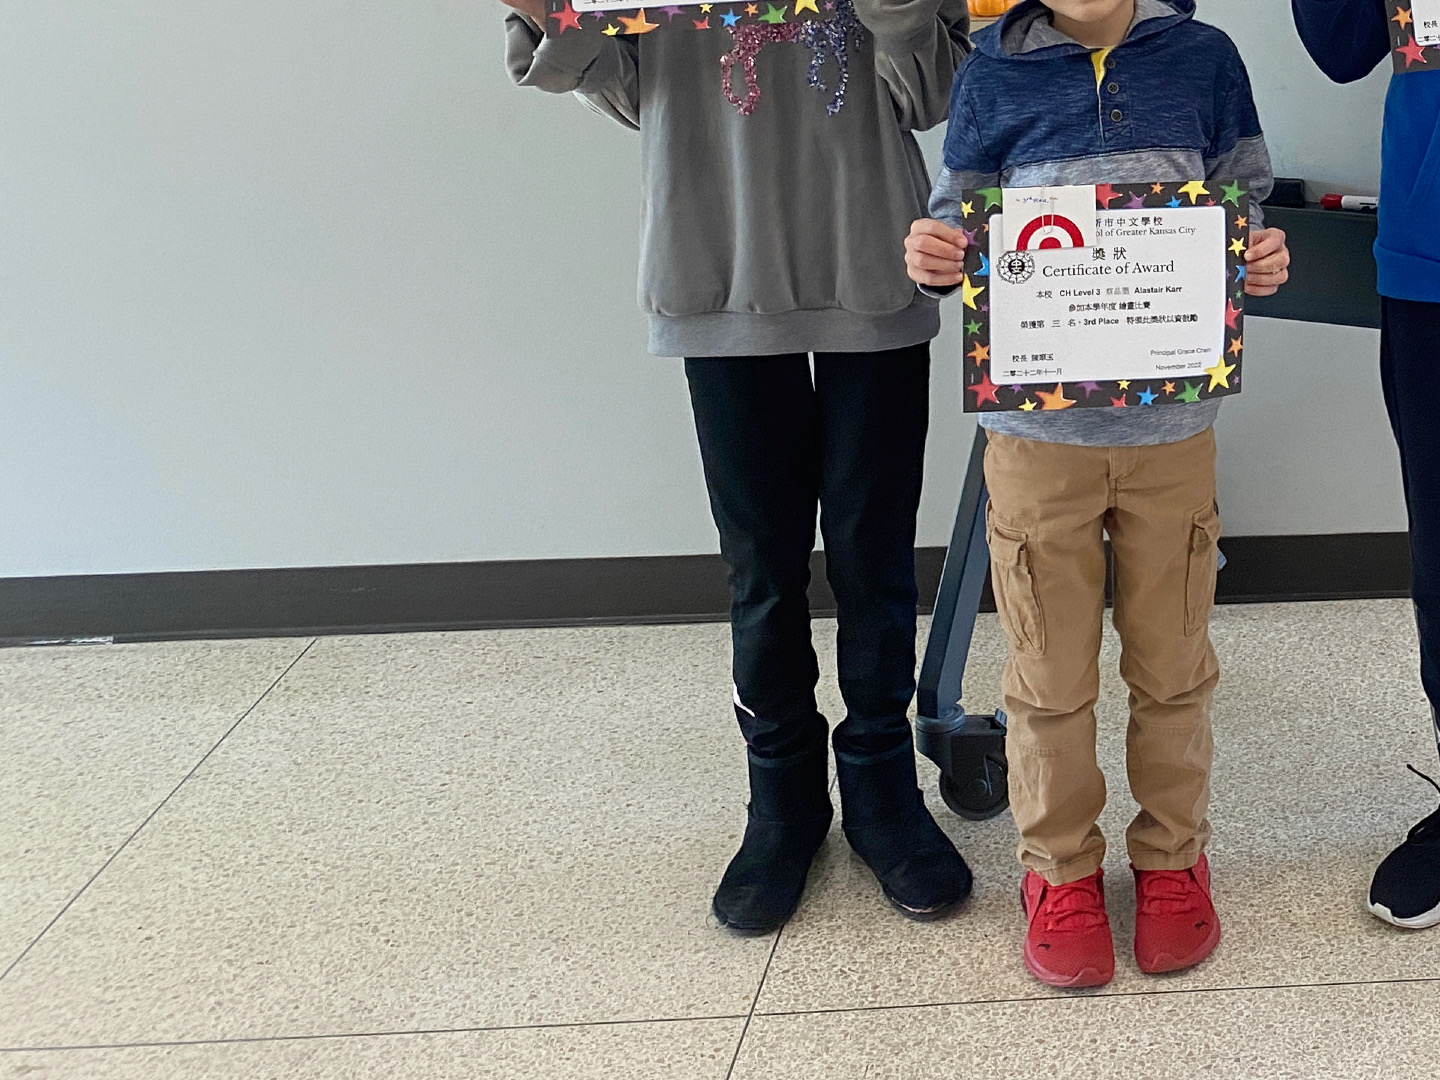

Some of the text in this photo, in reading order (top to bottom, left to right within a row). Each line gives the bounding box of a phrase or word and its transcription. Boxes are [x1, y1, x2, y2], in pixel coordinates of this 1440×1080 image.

[1106, 229, 1116, 237] of
[1117, 228, 1147, 236] Greater
[1149, 227, 1177, 235] Kansas
[1178, 226, 1196, 236] City
[1042, 261, 1175, 278] Certificate of Award
[1059, 289, 1072, 297] CH
[1074, 289, 1095, 297] Level
[1134, 286, 1164, 294] Alastair
[1052, 320, 1061, 328] 三
[1083, 318, 1097, 326] 3rd
[1150, 349, 1176, 357] Principal
[1156, 363, 1186, 371] November
